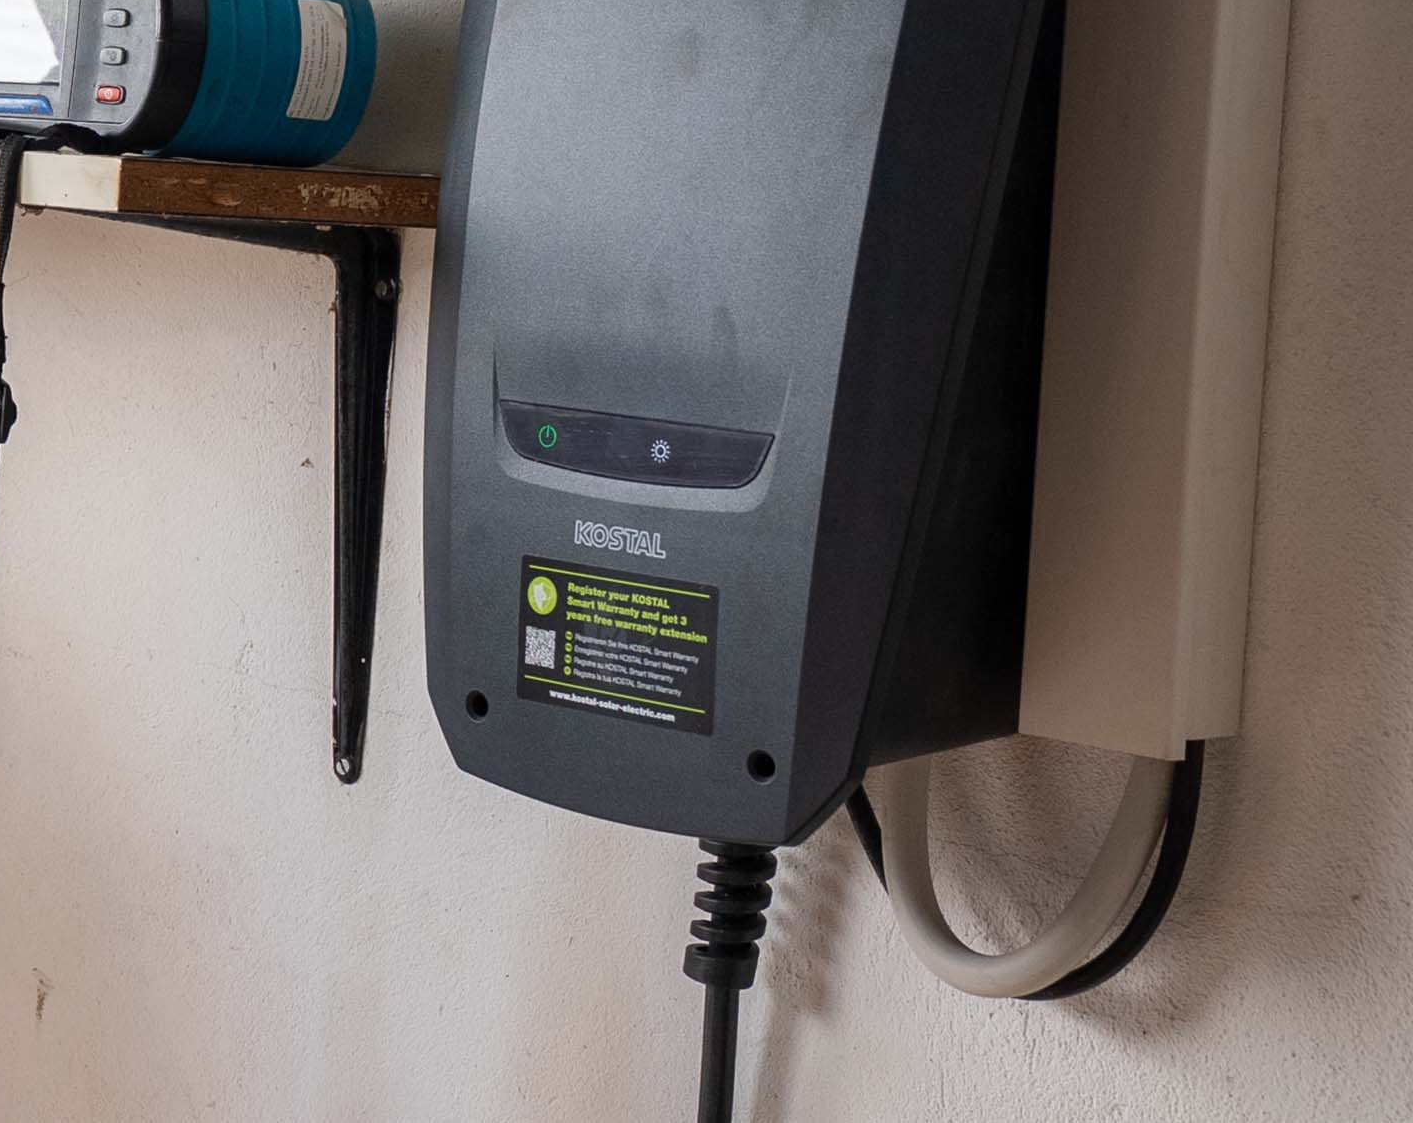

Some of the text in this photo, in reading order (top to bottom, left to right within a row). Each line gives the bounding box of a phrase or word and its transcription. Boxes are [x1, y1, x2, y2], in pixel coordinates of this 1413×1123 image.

[574, 519, 666, 559] KOSTAL
[567, 582, 671, 609] Register your KOSTAL
[566, 595, 687, 626] Smart Warranty and get 3
[566, 611, 709, 643] years free warranty extension
[629, 643, 653, 655] KOSTAL
[654, 647, 672, 659] Smart
[673, 650, 700, 665] Warranty
[643, 658, 661, 669] Smart
[662, 661, 689, 675] Warranty
[629, 667, 647, 678] Smart
[648, 670, 674, 684] Warranty
[637, 681, 655, 692] Smart
[655, 684, 682, 698] Warranty
[549, 690, 675, 722] www.kostal-solar-electric.com
